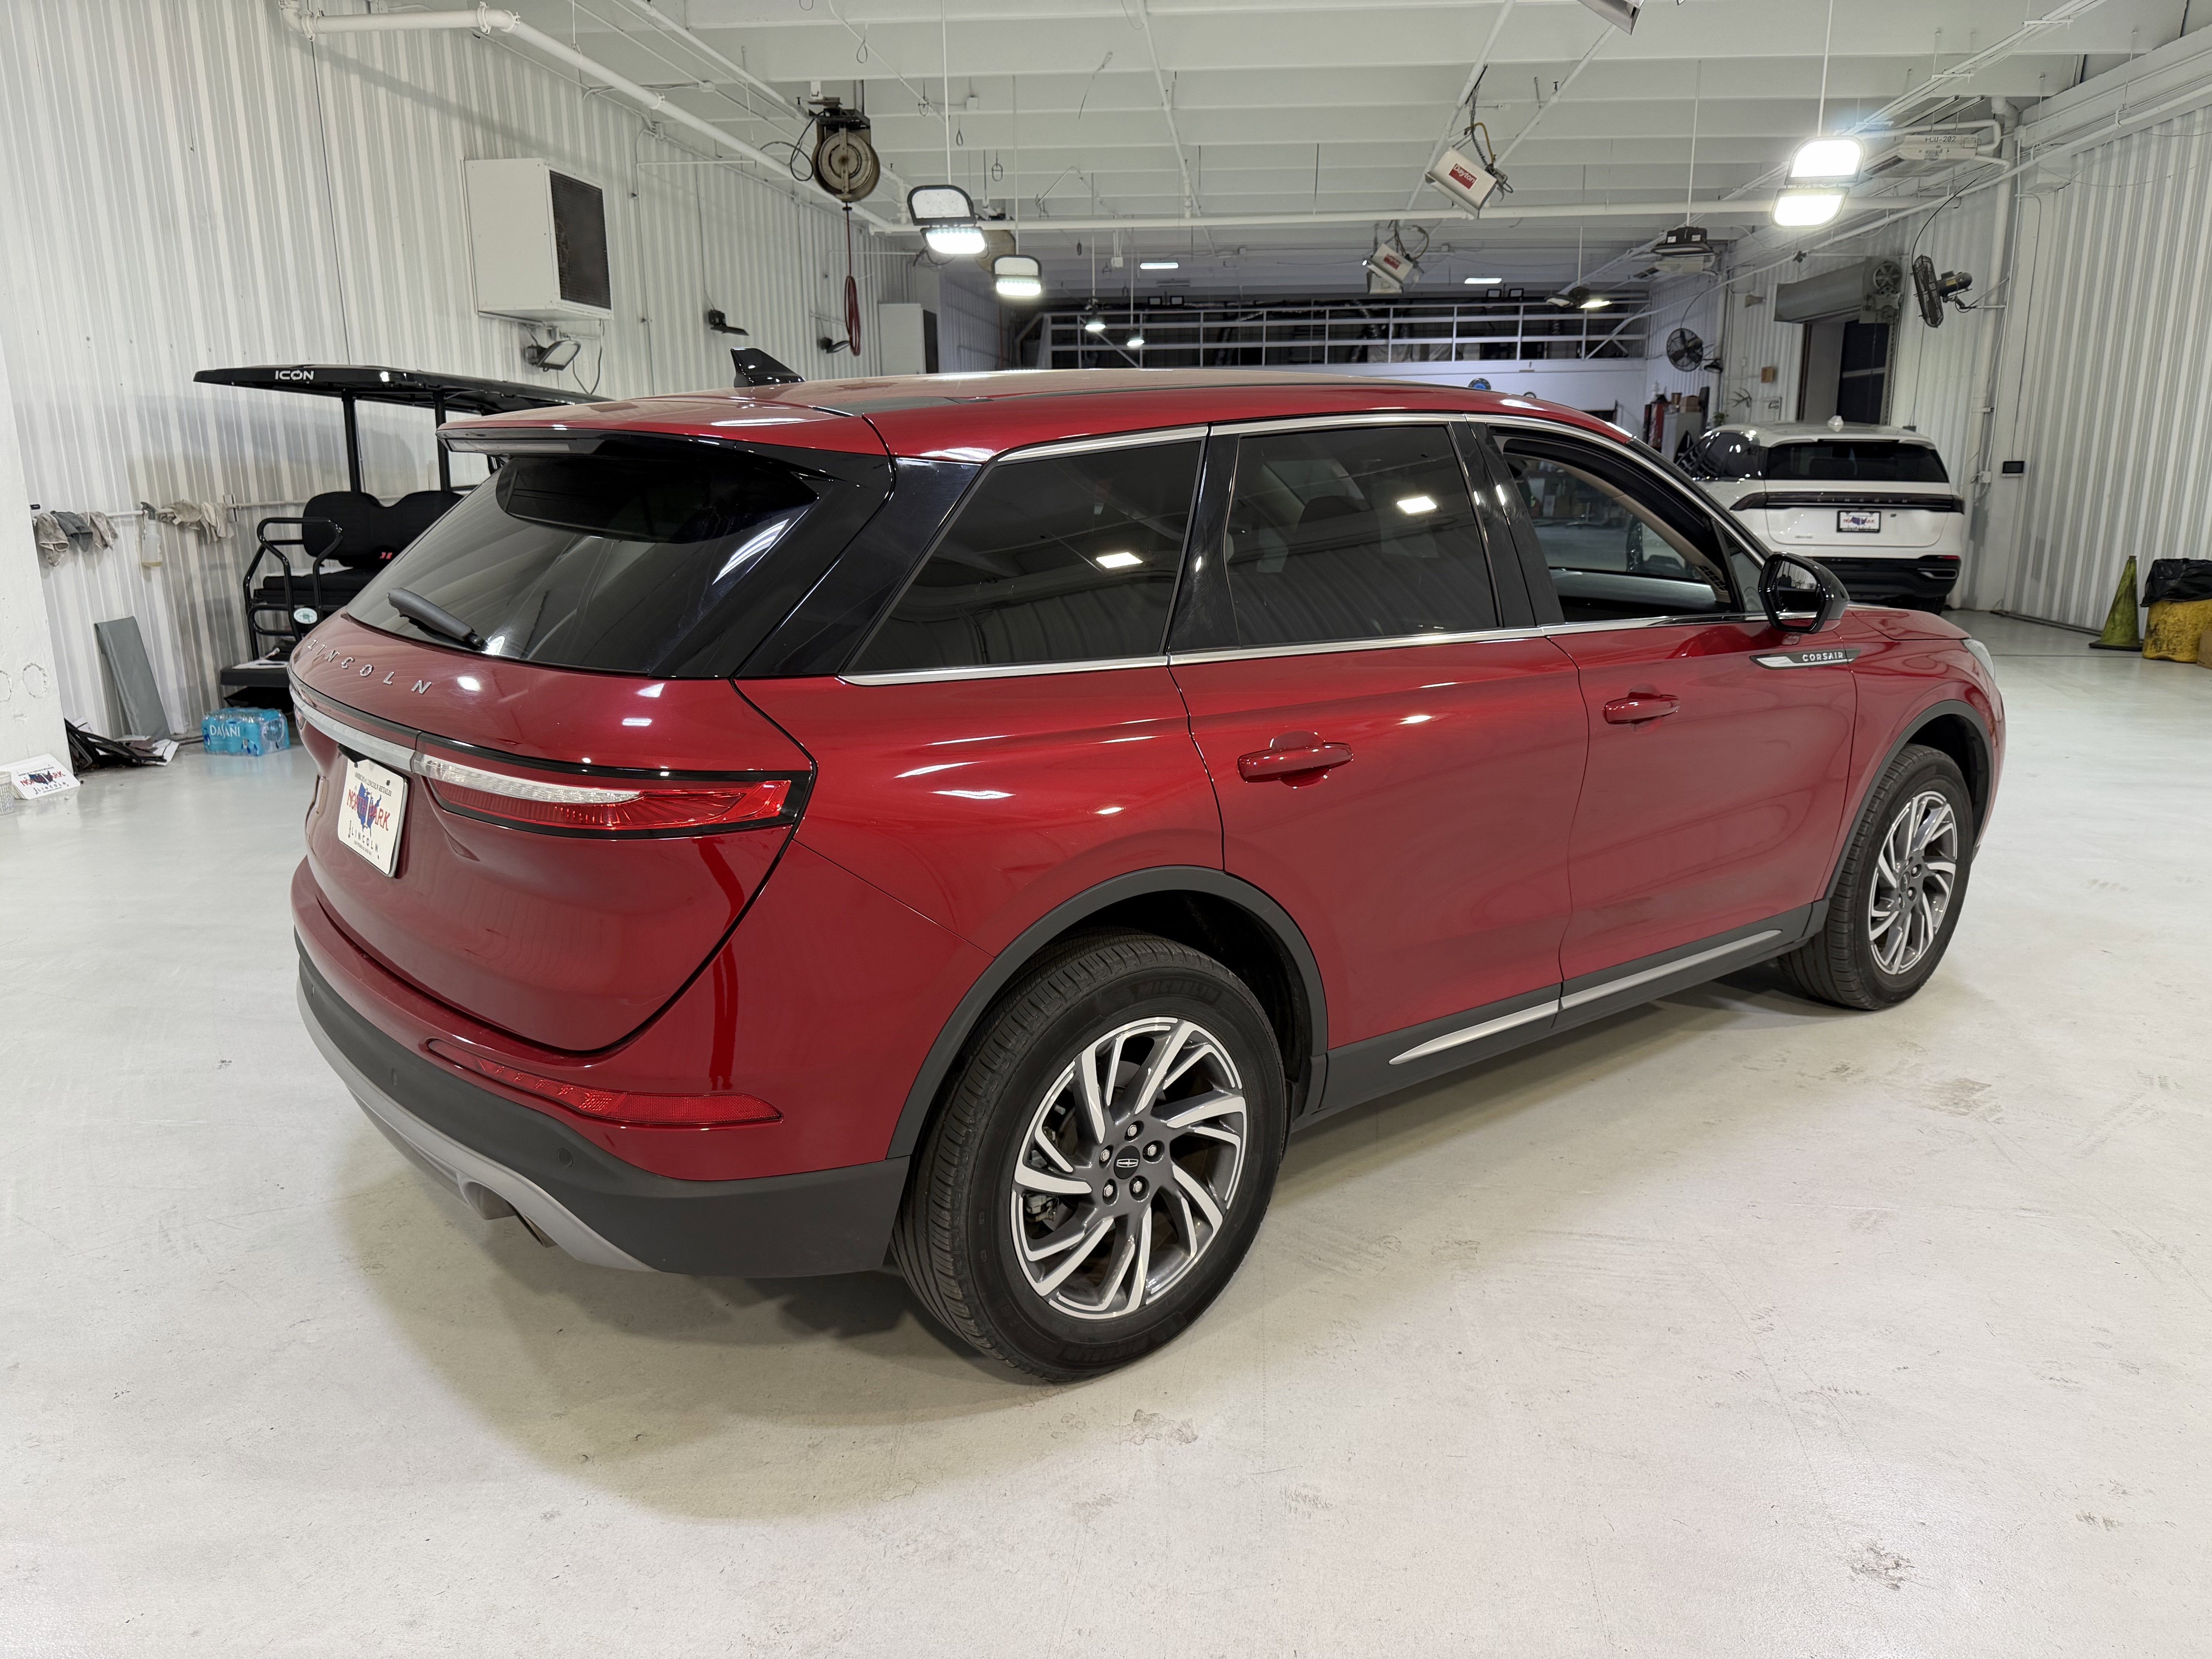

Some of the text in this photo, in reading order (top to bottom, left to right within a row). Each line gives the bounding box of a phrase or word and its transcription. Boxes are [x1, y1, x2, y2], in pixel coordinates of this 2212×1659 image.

[1453, 165, 1475, 183] Dayton
[275, 370, 314, 380] ICON
[308, 639, 434, 694] LINCOLN
[1802, 652, 1843, 662] CORSAIR
[210, 723, 240, 740] DASANI
[347, 789, 390, 831] NORTH PARK
[351, 827, 378, 852] LINCOLN
[1137, 980, 1219, 1002] MICHELIN
